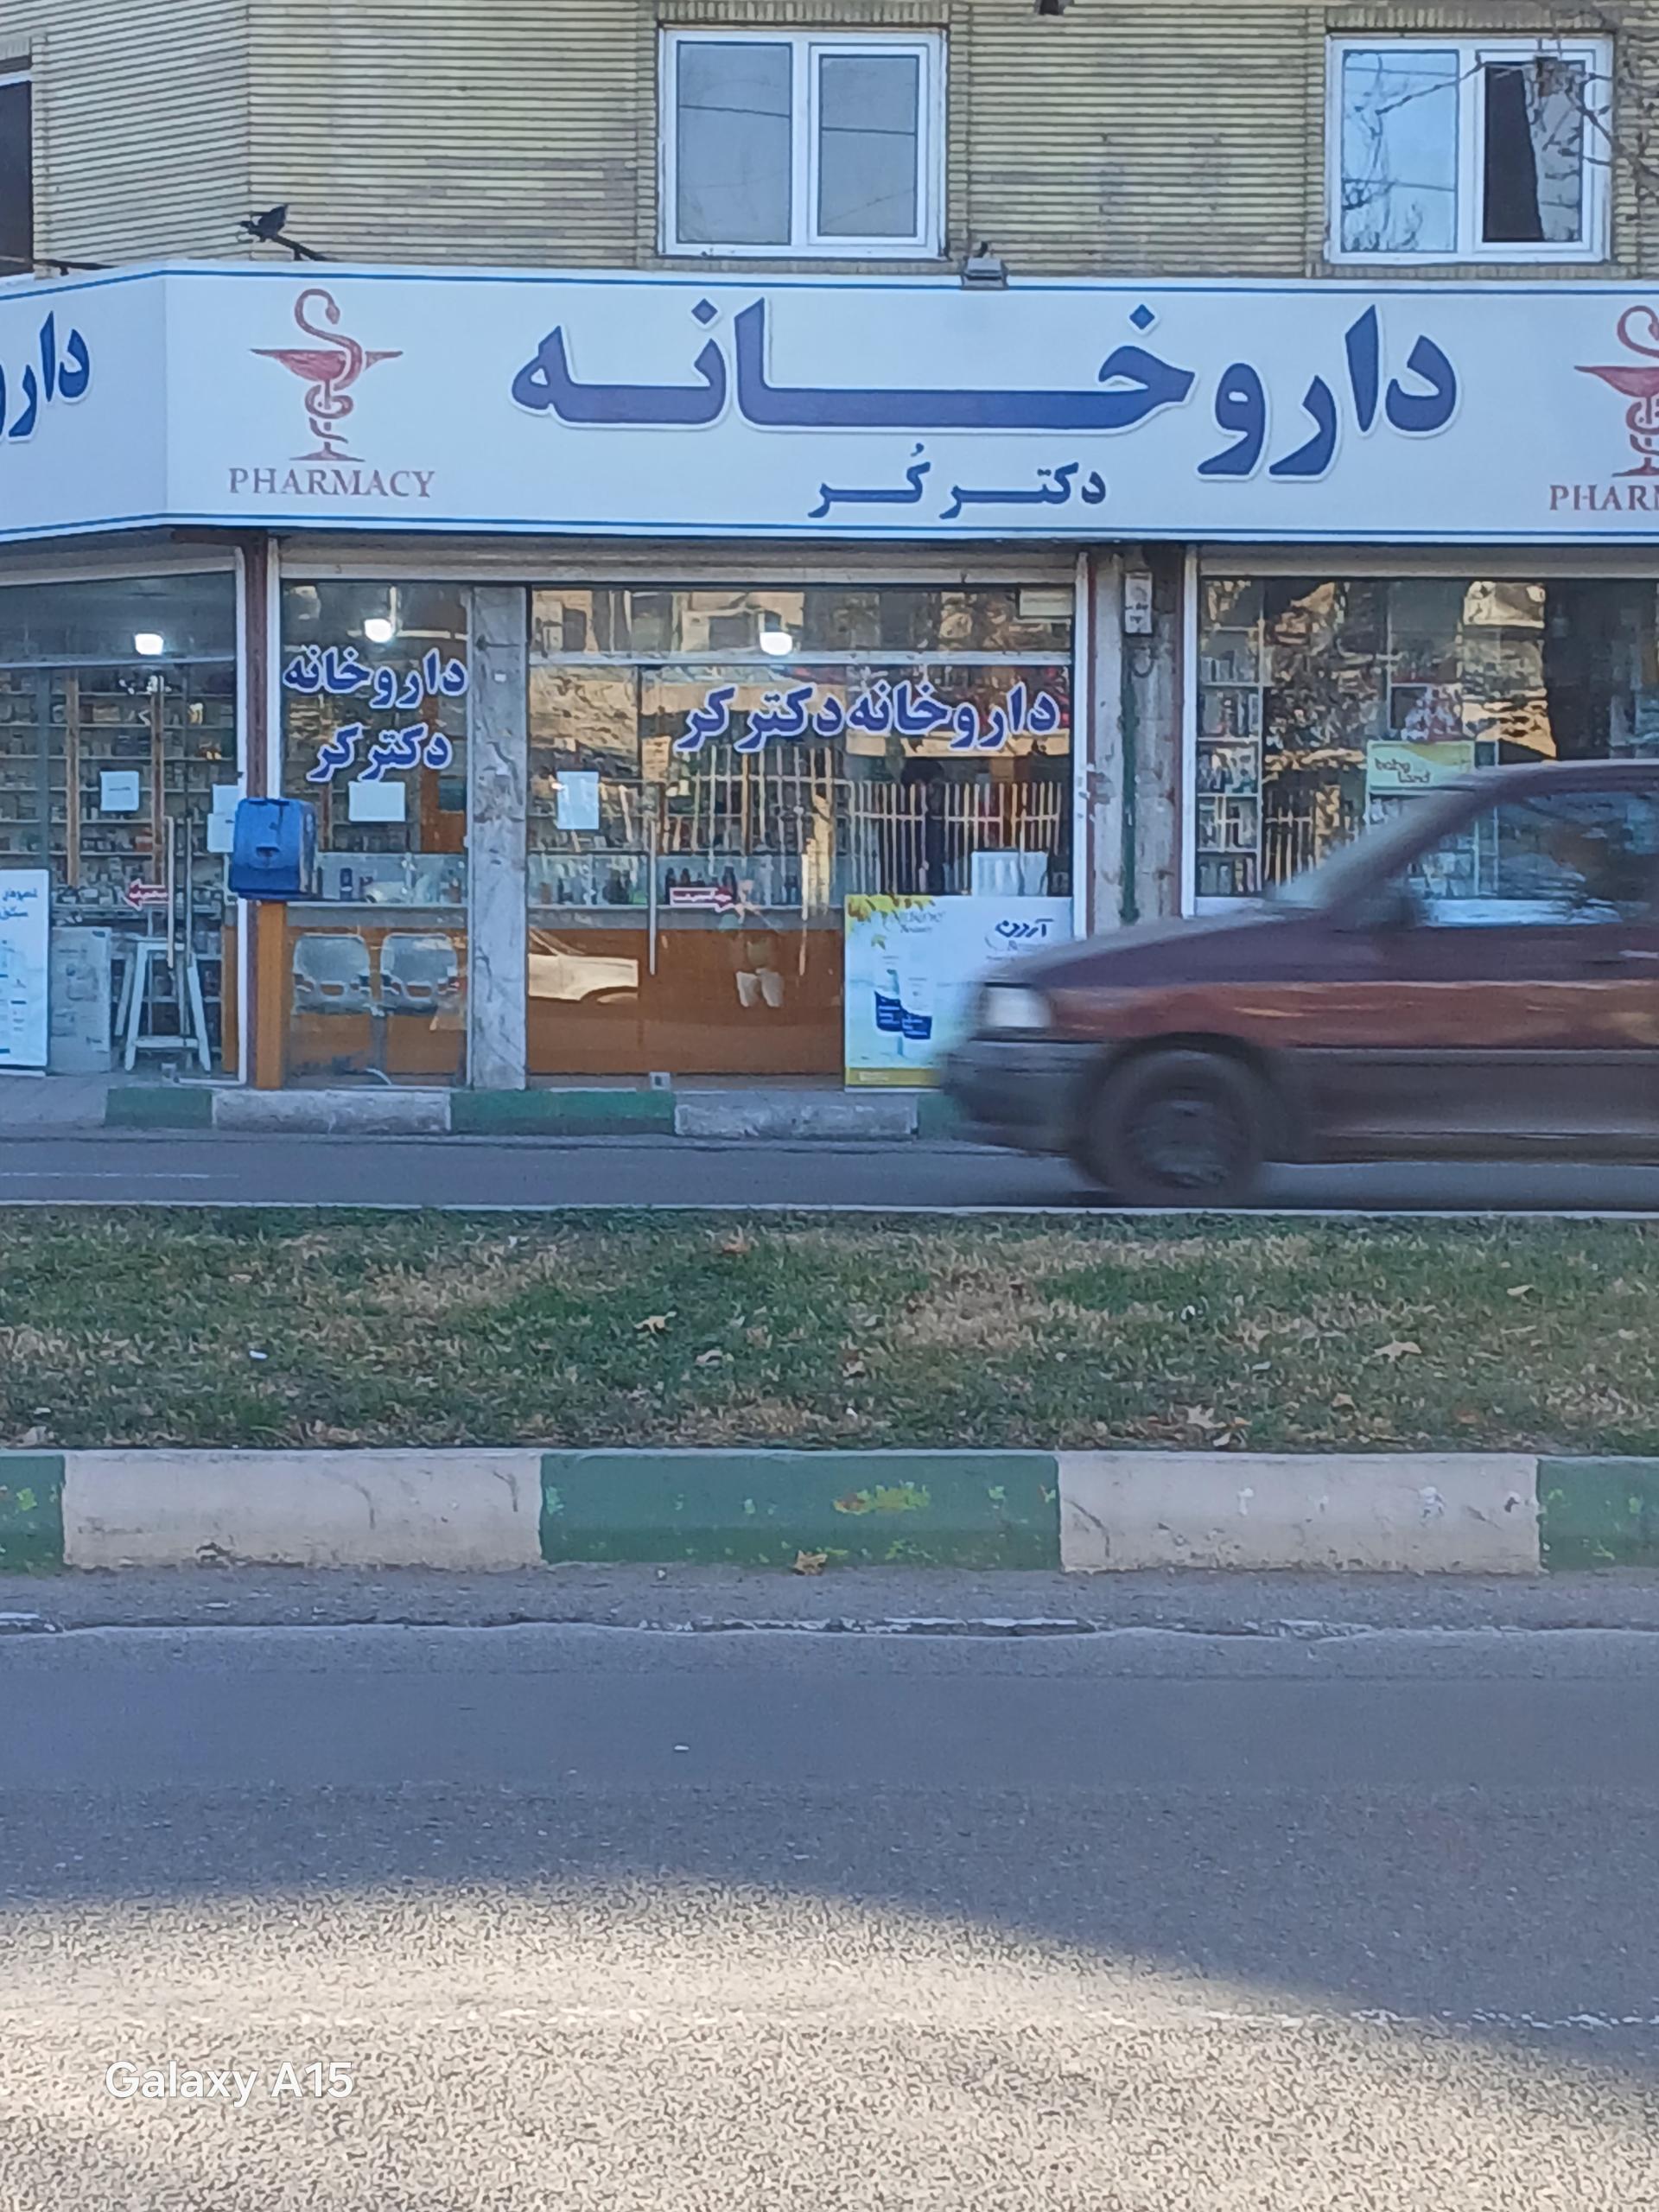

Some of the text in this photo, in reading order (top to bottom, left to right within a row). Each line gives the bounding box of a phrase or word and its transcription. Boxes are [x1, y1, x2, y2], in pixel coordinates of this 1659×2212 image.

[0, 310, 90, 439] دار
[512, 296, 1458, 476] داروخانه
[228, 467, 435, 499] PHARMACY
[938, 461, 1106, 519] دکتر
[1549, 484, 1659, 512] PHAR
[283, 645, 467, 708] داروخانه
[673, 676, 1060, 753] داروخانه دکتر کر
[306, 722, 453, 781] دکتر کر
